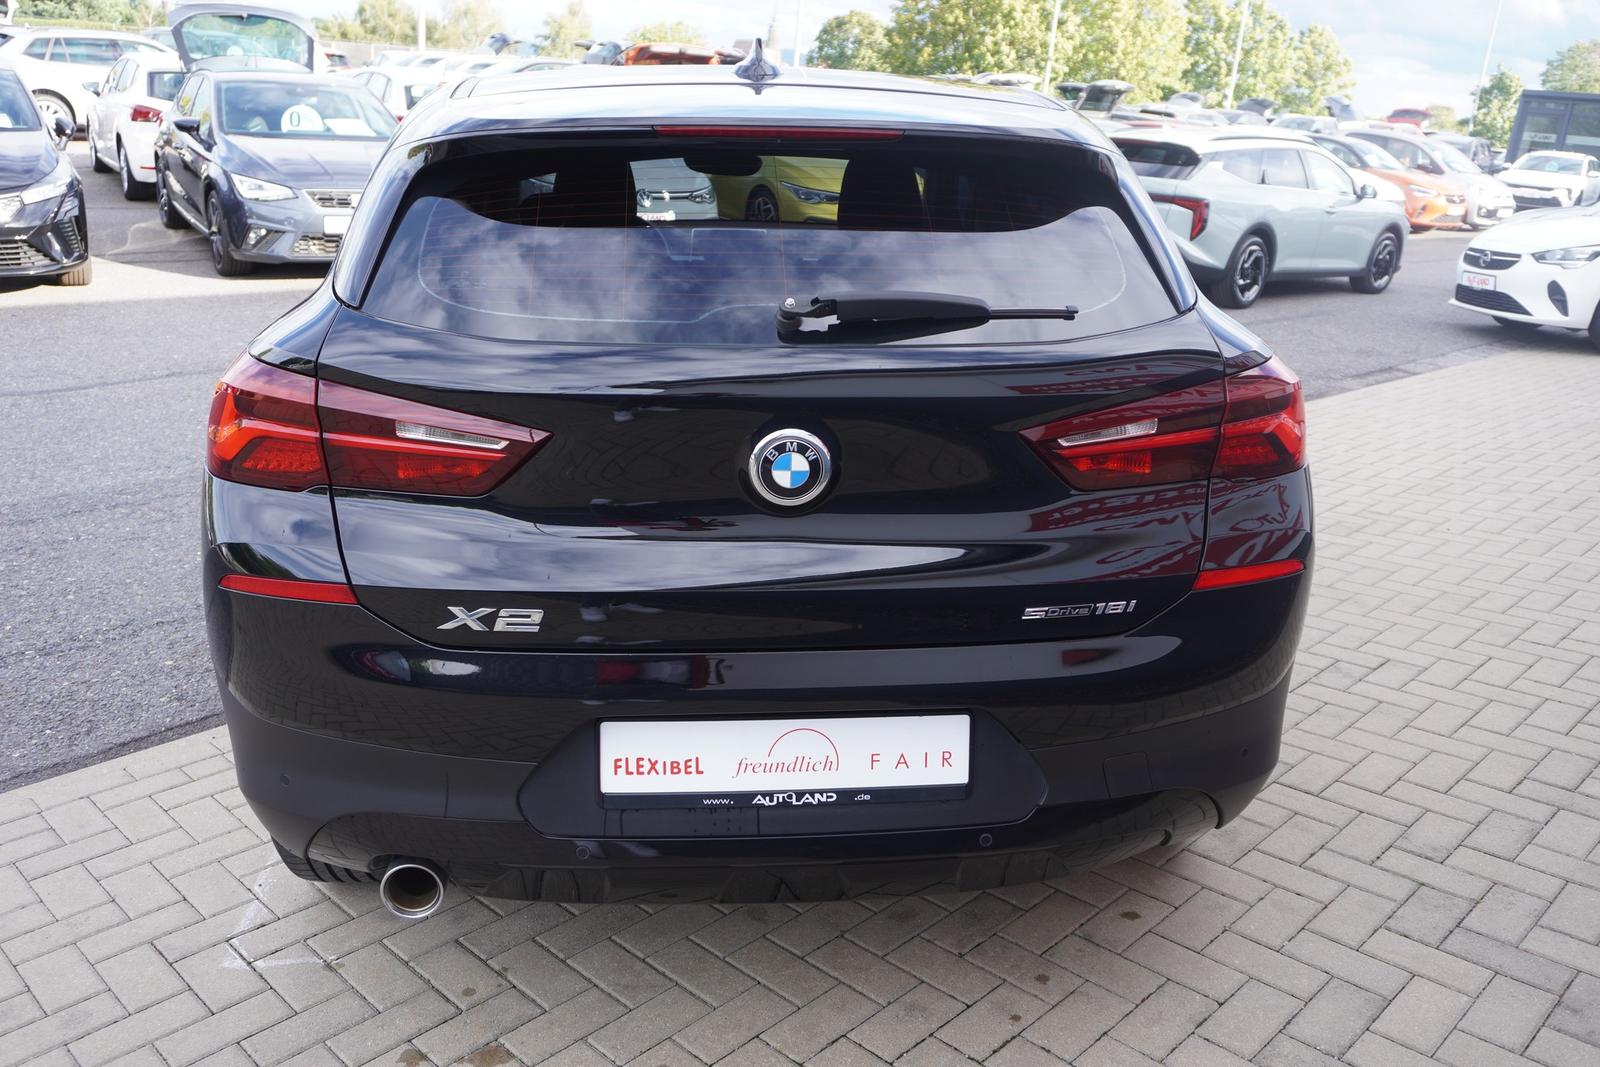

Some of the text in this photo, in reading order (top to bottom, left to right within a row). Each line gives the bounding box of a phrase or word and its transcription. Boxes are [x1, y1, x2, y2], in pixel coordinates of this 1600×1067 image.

[766, 441, 818, 462] BMW
[436, 606, 544, 633] X2
[613, 756, 705, 776] FLEXIBEL
[731, 754, 834, 779] freundlich
